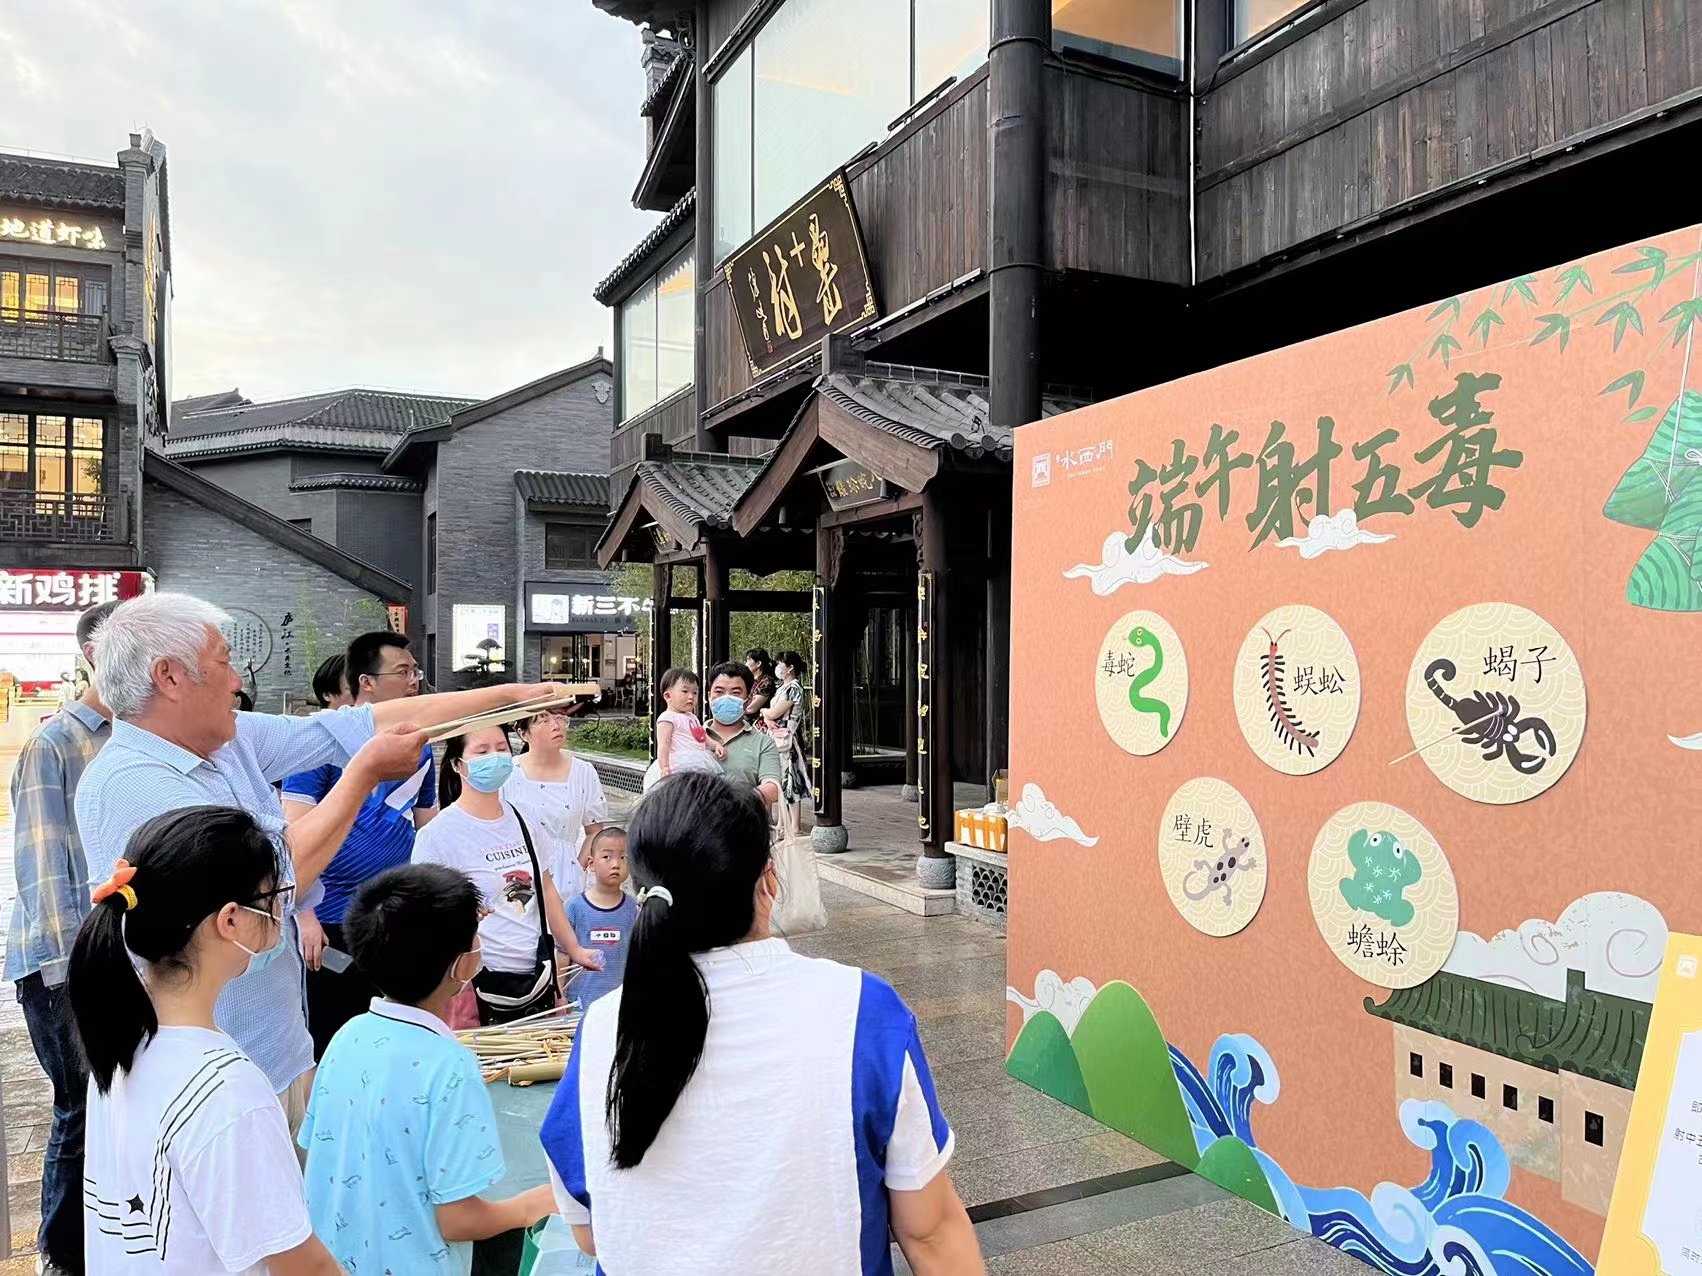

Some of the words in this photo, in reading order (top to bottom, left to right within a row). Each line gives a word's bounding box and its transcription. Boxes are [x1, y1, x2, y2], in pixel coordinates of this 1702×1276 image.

[1124, 372, 1523, 556] 端午射五毒
[0, 571, 121, 606] 新鸡排
[1102, 650, 1135, 677] 毒蛇
[1293, 665, 1346, 696] 蜈蚣
[1483, 645, 1557, 684] 蝎子
[1173, 813, 1214, 848] 壁虎
[1347, 923, 1407, 967] 蟾蜍
